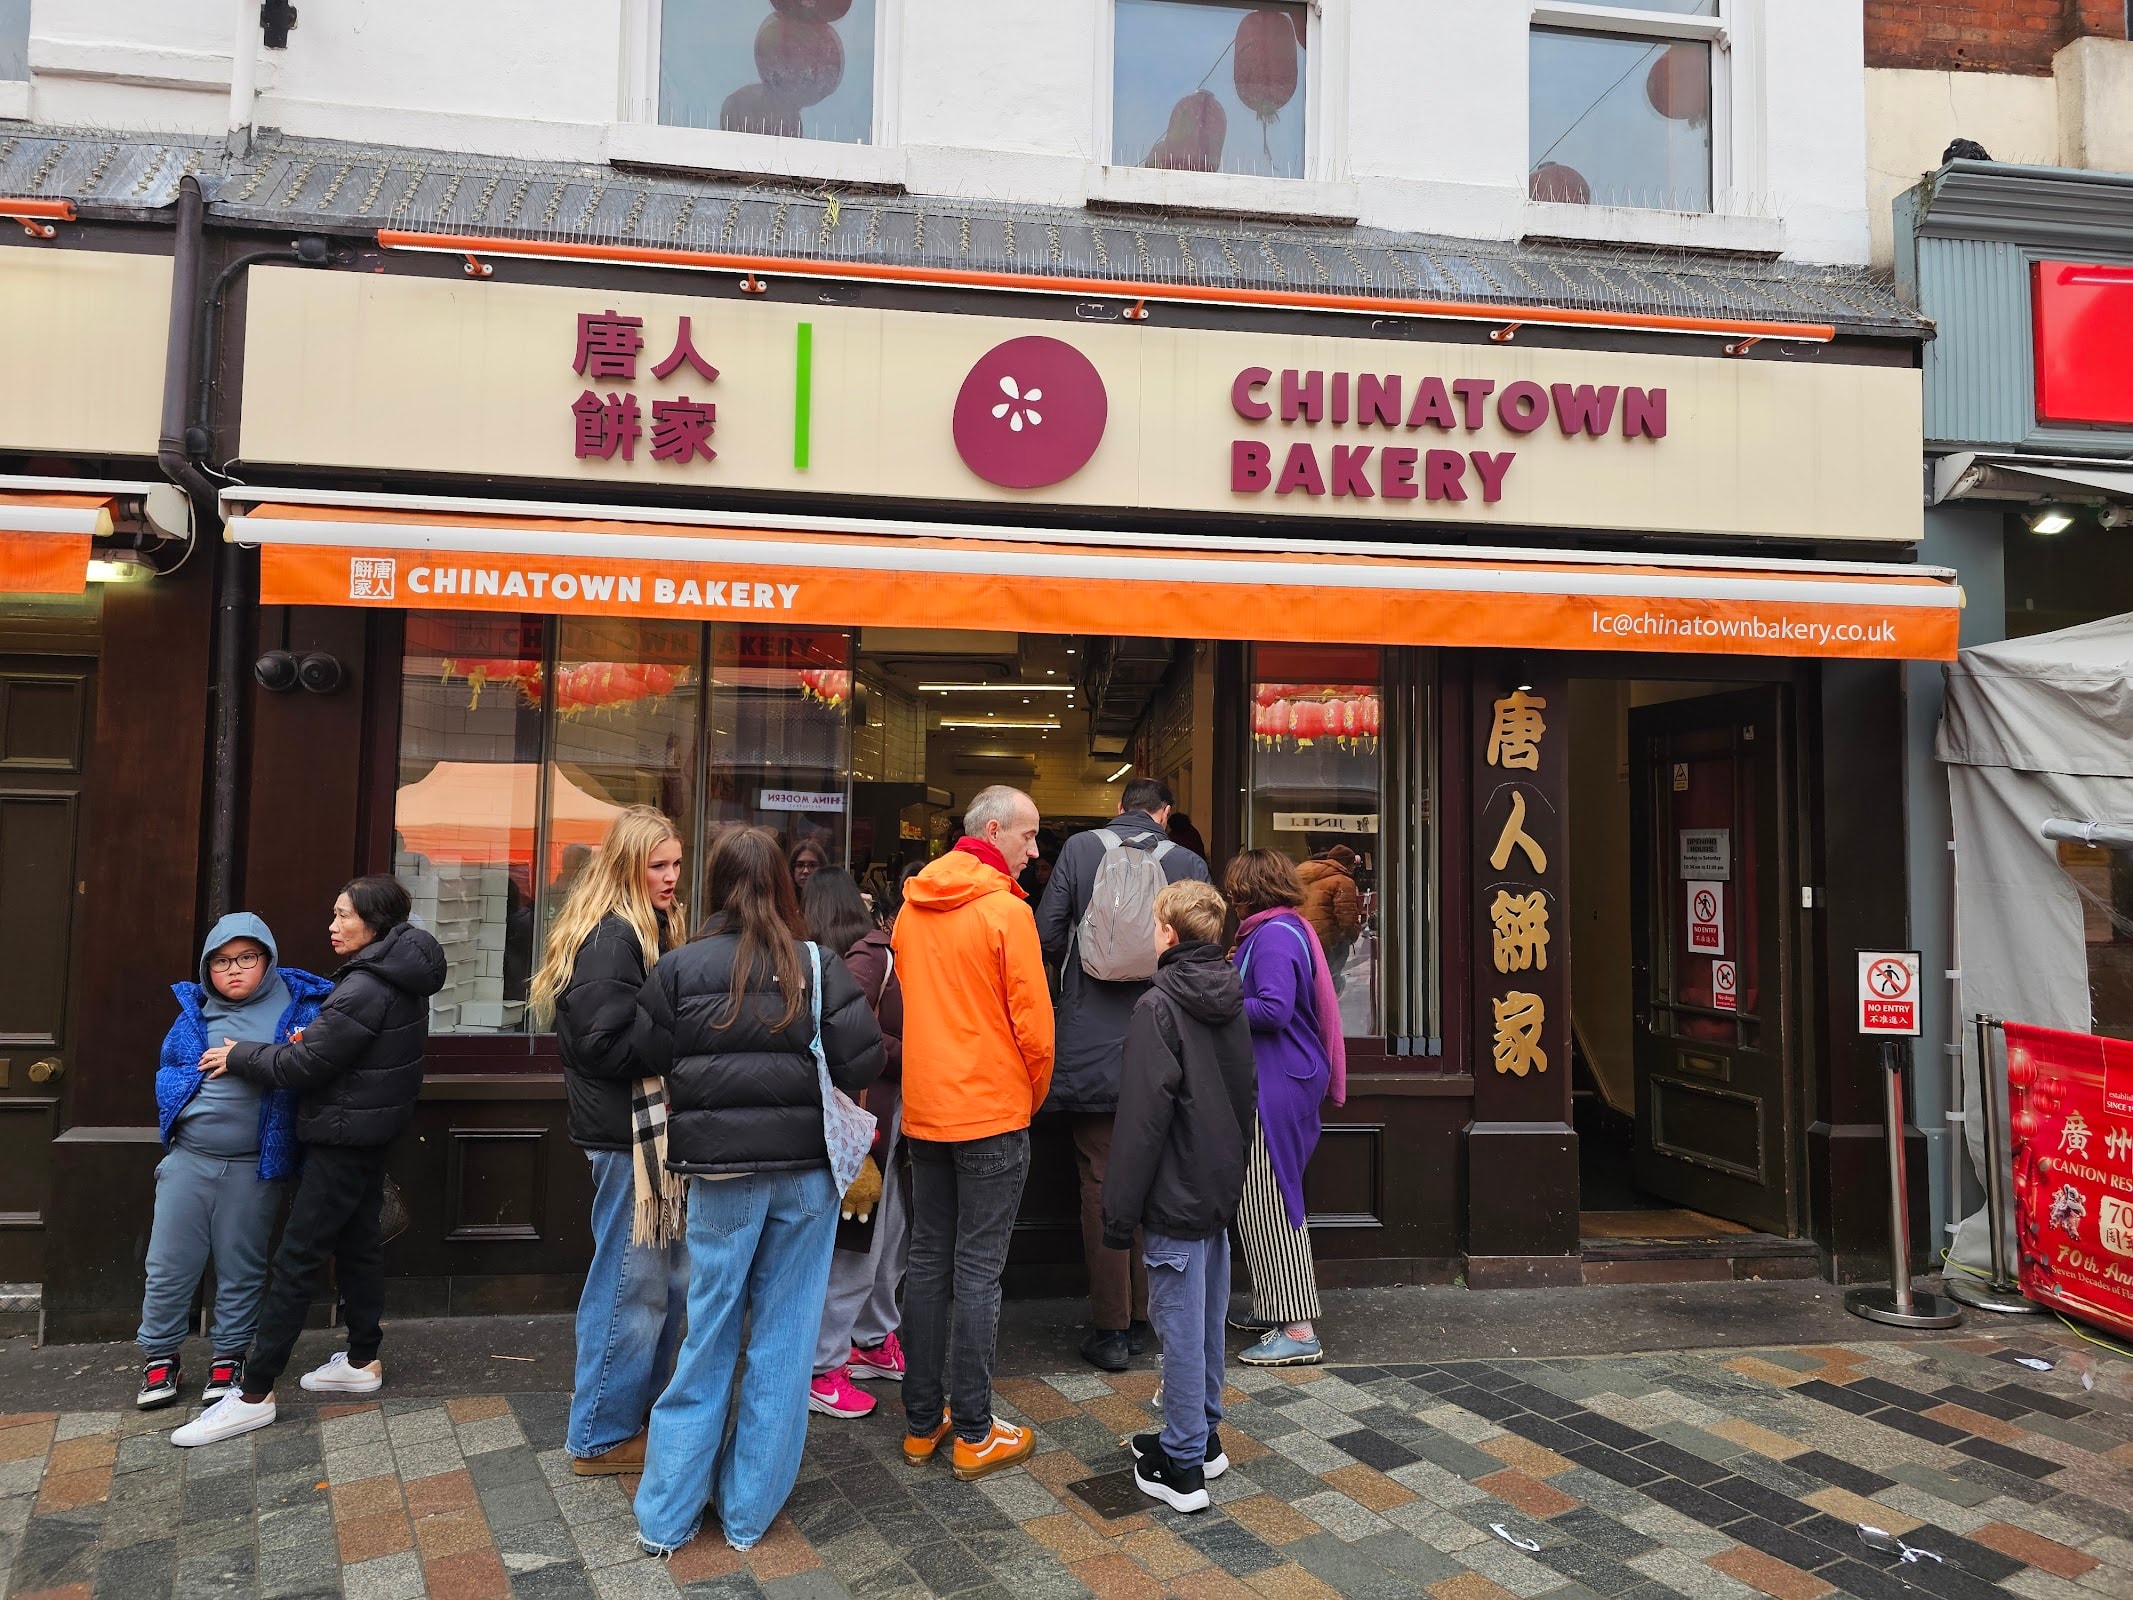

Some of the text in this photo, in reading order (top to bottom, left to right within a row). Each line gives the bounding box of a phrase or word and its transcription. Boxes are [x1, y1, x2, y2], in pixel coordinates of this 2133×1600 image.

[572, 309, 720, 383] 唐人
[1231, 366, 1667, 439] CHINATOWN
[571, 389, 718, 464] 餅家
[1230, 440, 1517, 503] BAKERY
[407, 567, 800, 609] CHINATOWN BAKERY
[1687, 838, 1717, 846] OPENING
[1486, 690, 1550, 1078] 唐人餅家
[1702, 926, 1717, 934] ENTRY
[1868, 1004, 1910, 1013] NO ENTRY
[2106, 1100, 2127, 1111] SINCE
[2052, 1157, 2107, 1185] CANTON
[2056, 1244, 2100, 1274] 70th
[2051, 1264, 2077, 1280] Seven
[2078, 1273, 2111, 1291] Decades
[2111, 1286, 2121, 1296] of
